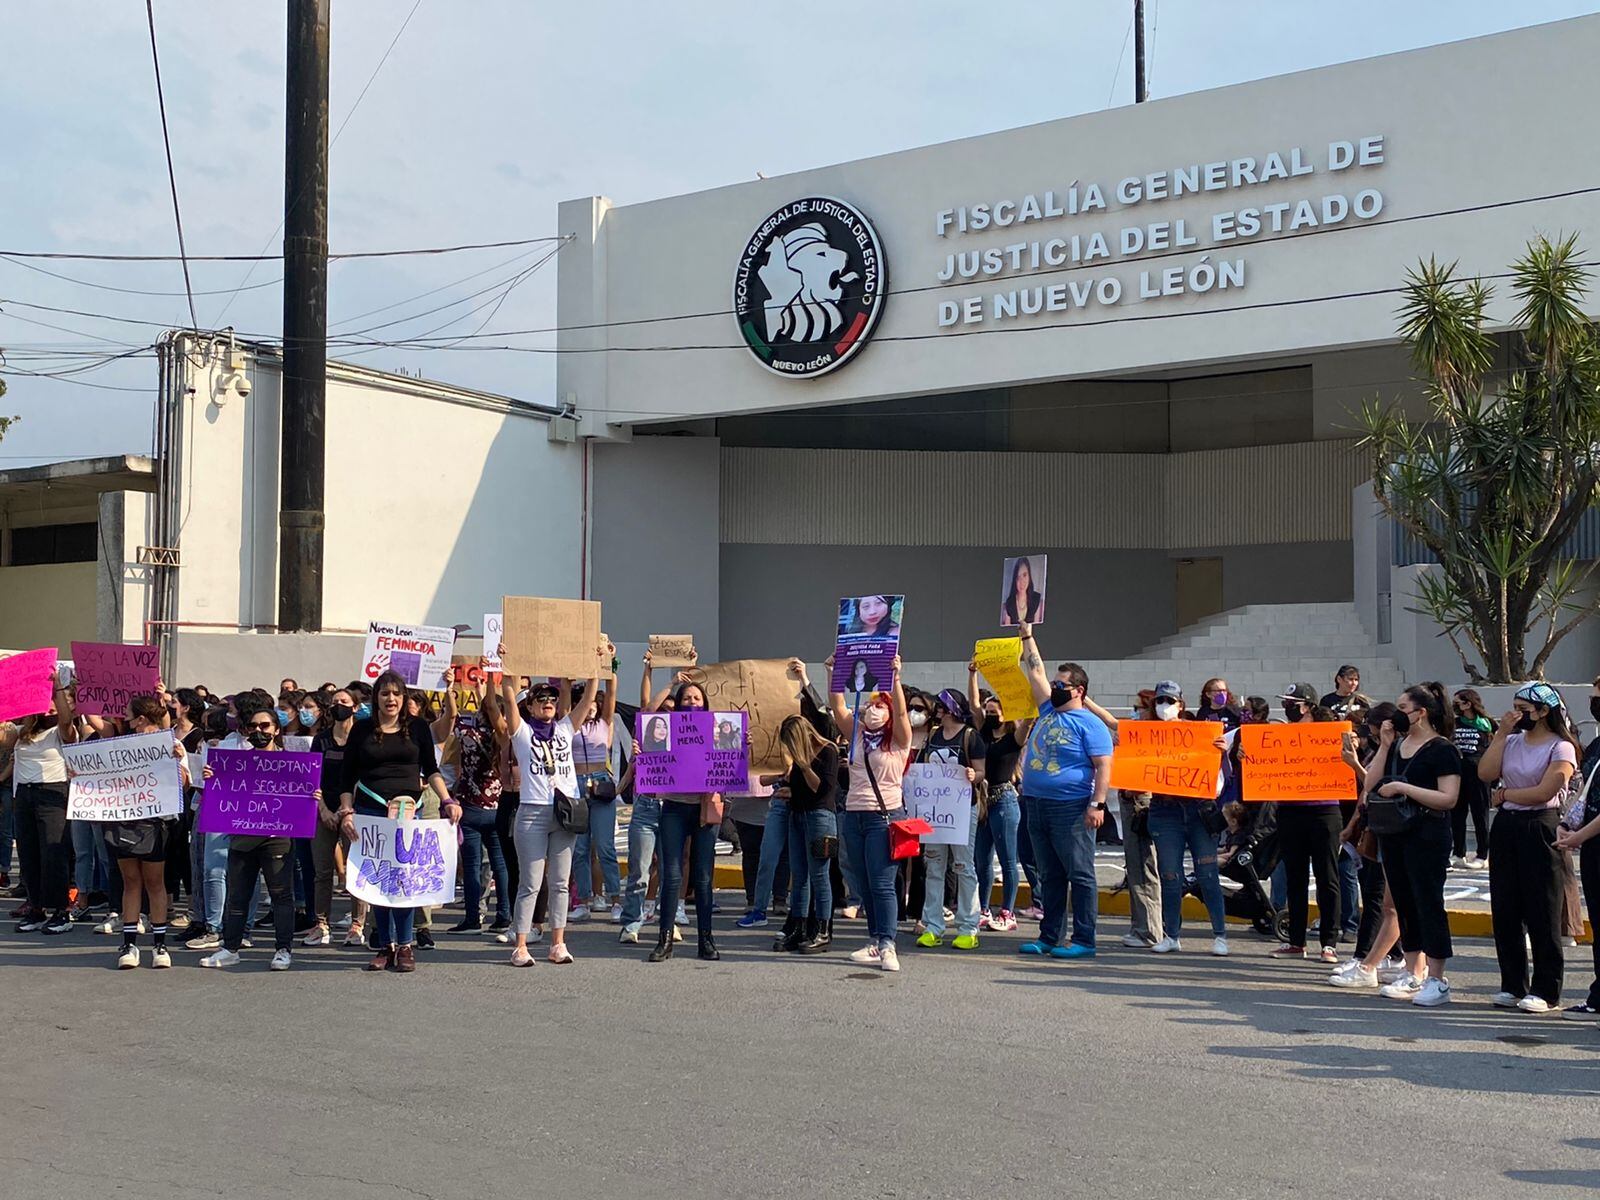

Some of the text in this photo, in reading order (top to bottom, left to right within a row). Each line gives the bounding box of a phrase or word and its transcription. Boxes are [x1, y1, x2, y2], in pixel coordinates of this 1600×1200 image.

[936, 134, 1385, 237] FISCALÍA GENERAL DE
[937, 188, 1385, 283] JUSTICIA DEL ESTADO
[736, 200, 876, 316] FISCALÍA GENERAL DE JUSTICIA DEL ESTADO
[937, 255, 1246, 328] DE NUEVO LEÓN
[771, 353, 833, 372] NUEVO LEÓN
[370, 621, 394, 635] Nuevo
[376, 636, 436, 656] FEMINICIDA
[114, 652, 129, 667] LA
[133, 651, 157, 668] VOZ
[80, 668, 142, 687] DE QUIEN
[735, 662, 756, 696] ti
[681, 714, 693, 722] NI
[678, 724, 698, 734] UNA
[677, 735, 705, 745] MENOS
[1261, 731, 1282, 748] En
[1289, 733, 1302, 748] el
[68, 753, 106, 772] MARIA
[637, 754, 677, 765] JUSTICIA
[704, 751, 745, 761] JUSTICIA
[1245, 754, 1279, 765] Nuevo
[235, 760, 247, 771] SI
[558, 765, 571, 778] up
[646, 766, 668, 775] PARA
[713, 762, 735, 770] PARA
[75, 772, 158, 796] NO ESTAMOS
[211, 778, 315, 794] A LA SEGURIDAD
[639, 775, 676, 786] ANGELA
[705, 778, 746, 787] FERNANDA
[1143, 764, 1211, 793] FUERZA
[73, 789, 157, 808] COMPLETAS
[932, 787, 952, 804] que
[957, 787, 971, 804] ya
[72, 810, 96, 819] NOS
[102, 805, 143, 819] FALTAS
[219, 799, 239, 813] UN
[395, 827, 445, 866] UNA
